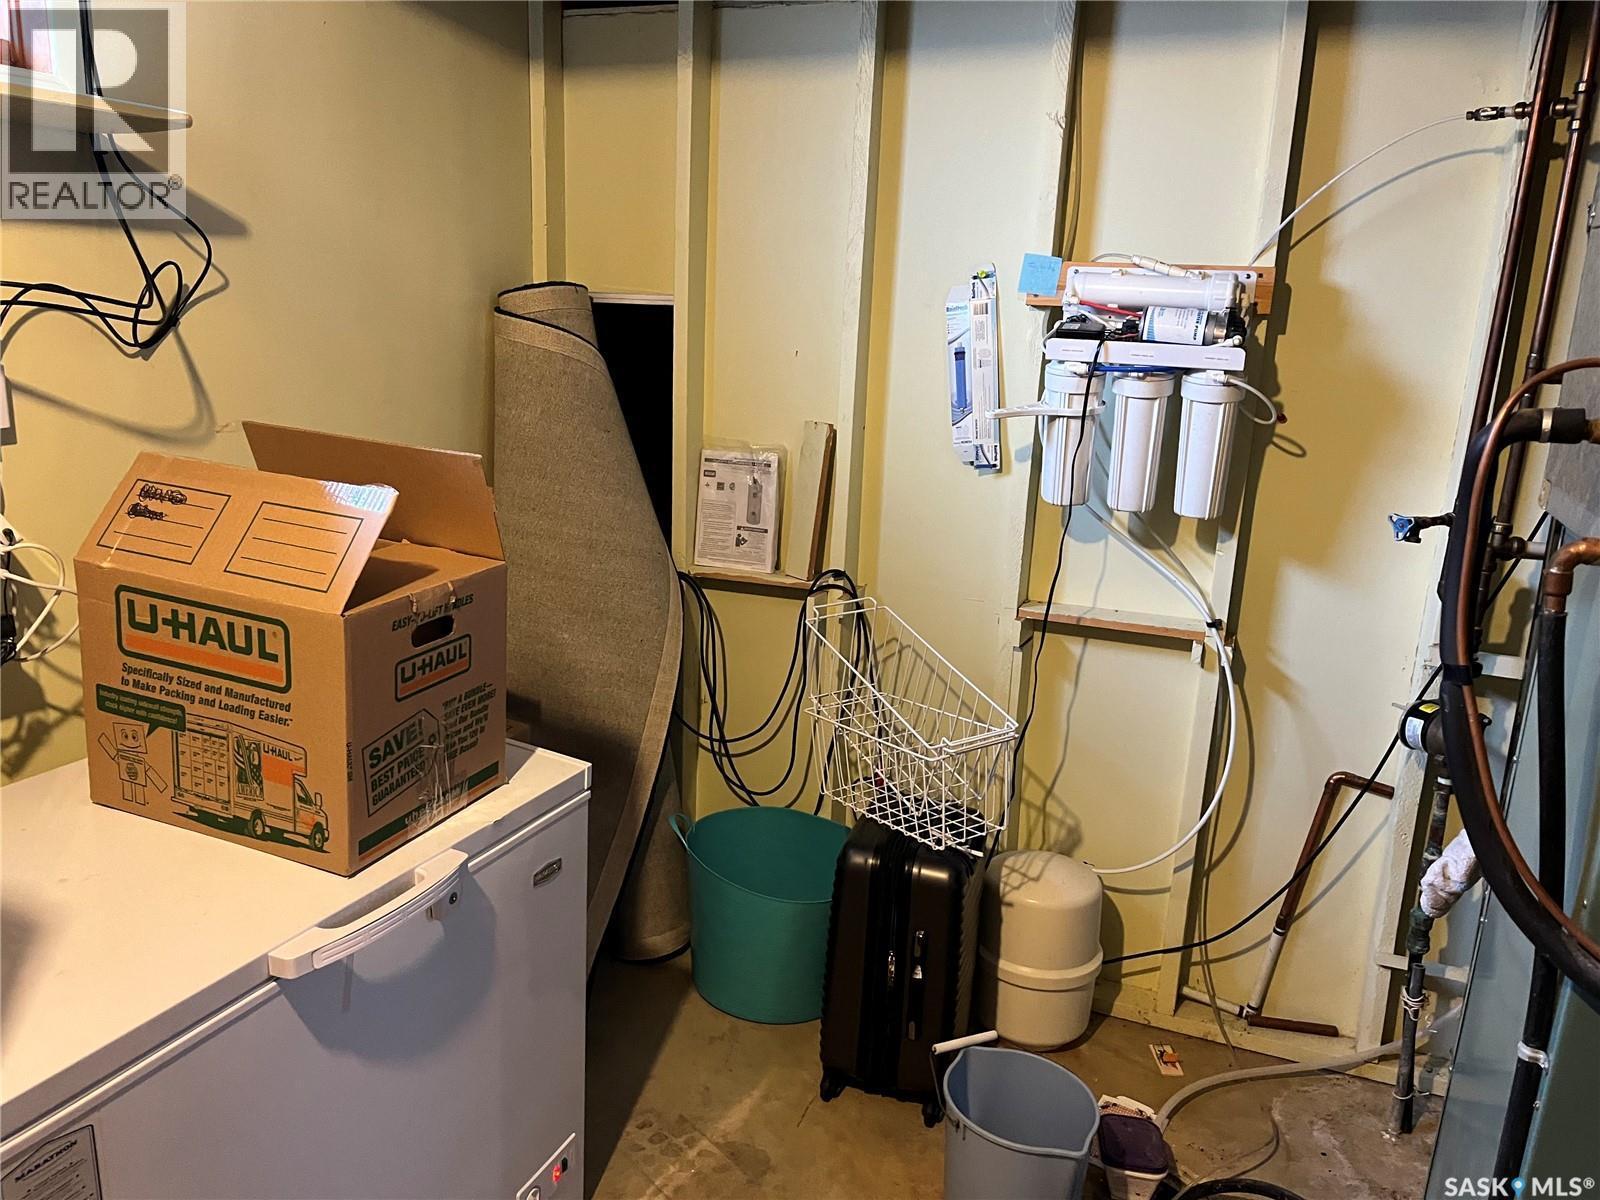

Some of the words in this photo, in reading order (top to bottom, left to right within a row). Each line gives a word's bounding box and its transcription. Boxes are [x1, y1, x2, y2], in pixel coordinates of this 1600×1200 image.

[401, 642, 468, 683] U-HAUL
[121, 662, 174, 685] Specifically
[176, 675, 202, 690] Sized
[204, 681, 222, 696] and
[224, 686, 292, 713] Manufactured
[121, 676, 130, 687] to
[132, 679, 156, 694] Make
[159, 683, 196, 705] Packing
[198, 695, 216, 708] and
[218, 700, 256, 720] Loading
[368, 718, 423, 769] SAVE!
[371, 765, 396, 793] BEST
[397, 747, 425, 771] PRICE
[372, 760, 426, 806] GUARANTEED
